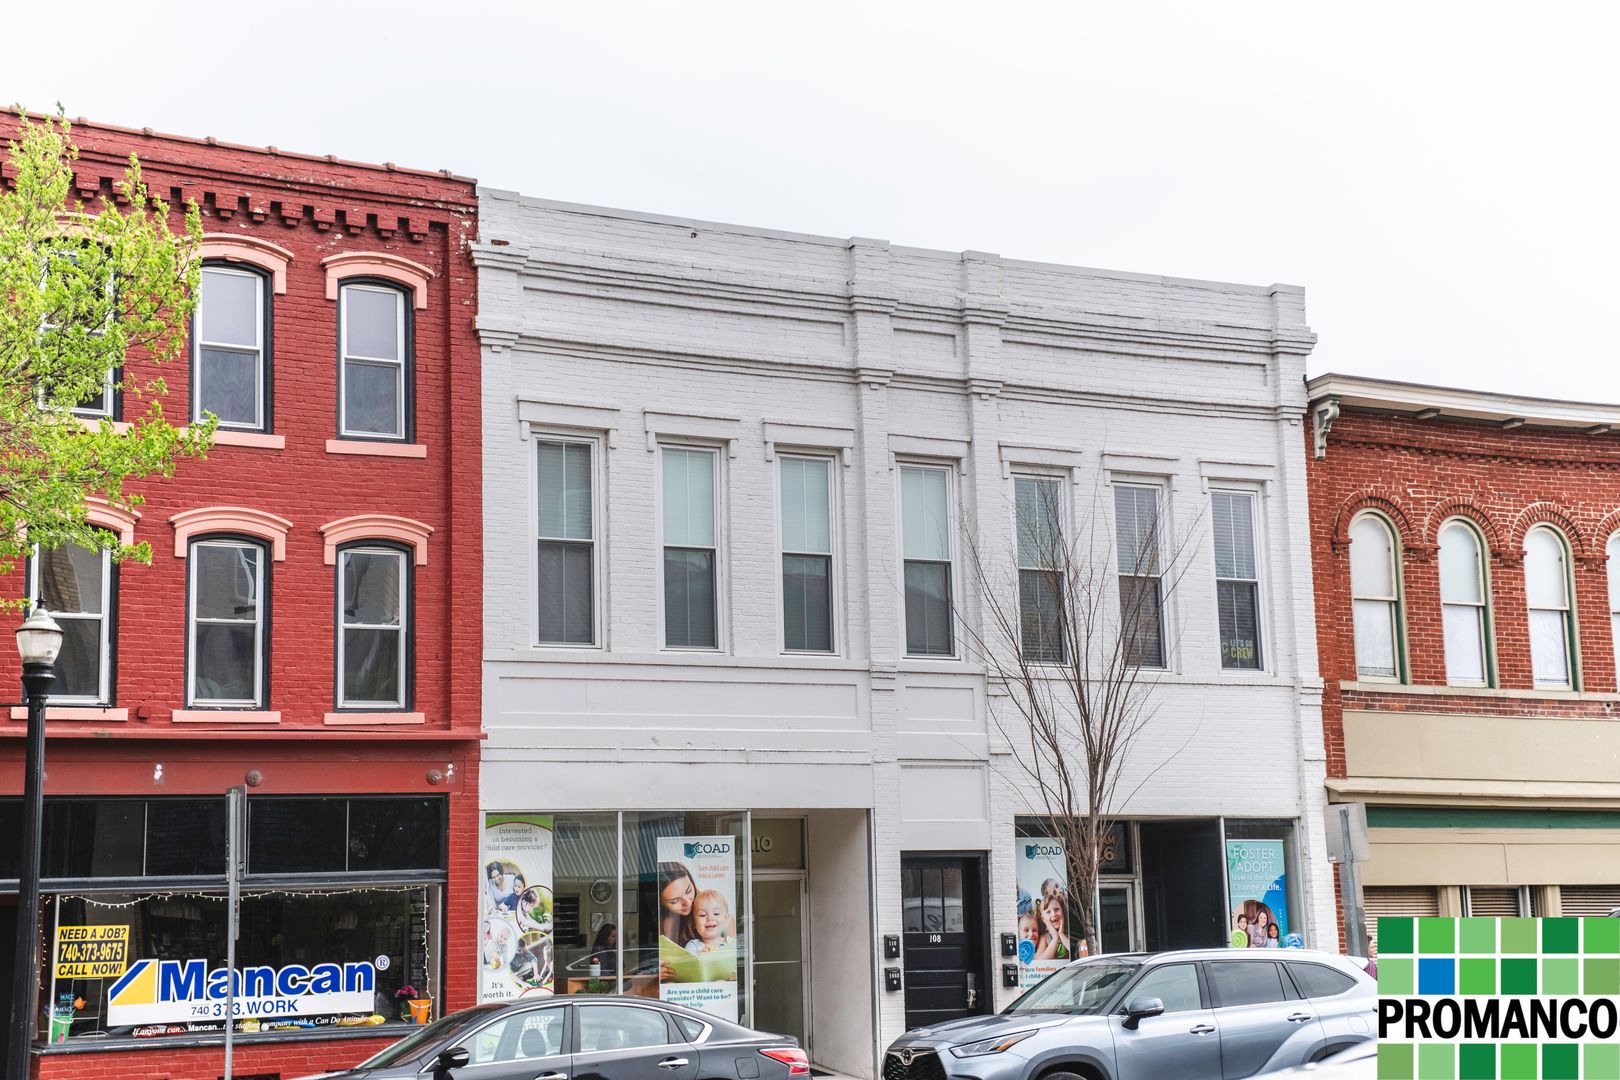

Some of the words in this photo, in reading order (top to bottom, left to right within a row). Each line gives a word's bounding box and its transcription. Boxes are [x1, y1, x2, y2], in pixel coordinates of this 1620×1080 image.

[1230, 647, 1253, 659] CREW
[501, 835, 533, 843] becoming
[516, 843, 548, 851] provider?
[694, 843, 731, 854] COAD
[1034, 846, 1063, 856] COAD
[1233, 883, 1259, 893] Change
[60, 929, 87, 940] NEED
[90, 929, 97, 939] A
[100, 928, 126, 939] JOB?
[929, 935, 942, 943] 108
[60, 943, 123, 962] 740-373-9675
[58, 965, 87, 976] CALL
[91, 964, 122, 975] NOW!
[159, 959, 375, 1001] Mancan
[491, 981, 504, 989] It's
[483, 990, 504, 999] worth
[191, 1005, 210, 1016] 740
[140, 1026, 165, 1036] anyone
[293, 1018, 308, 1026] with
[315, 1017, 330, 1025] Can
[330, 1015, 341, 1024] Do
